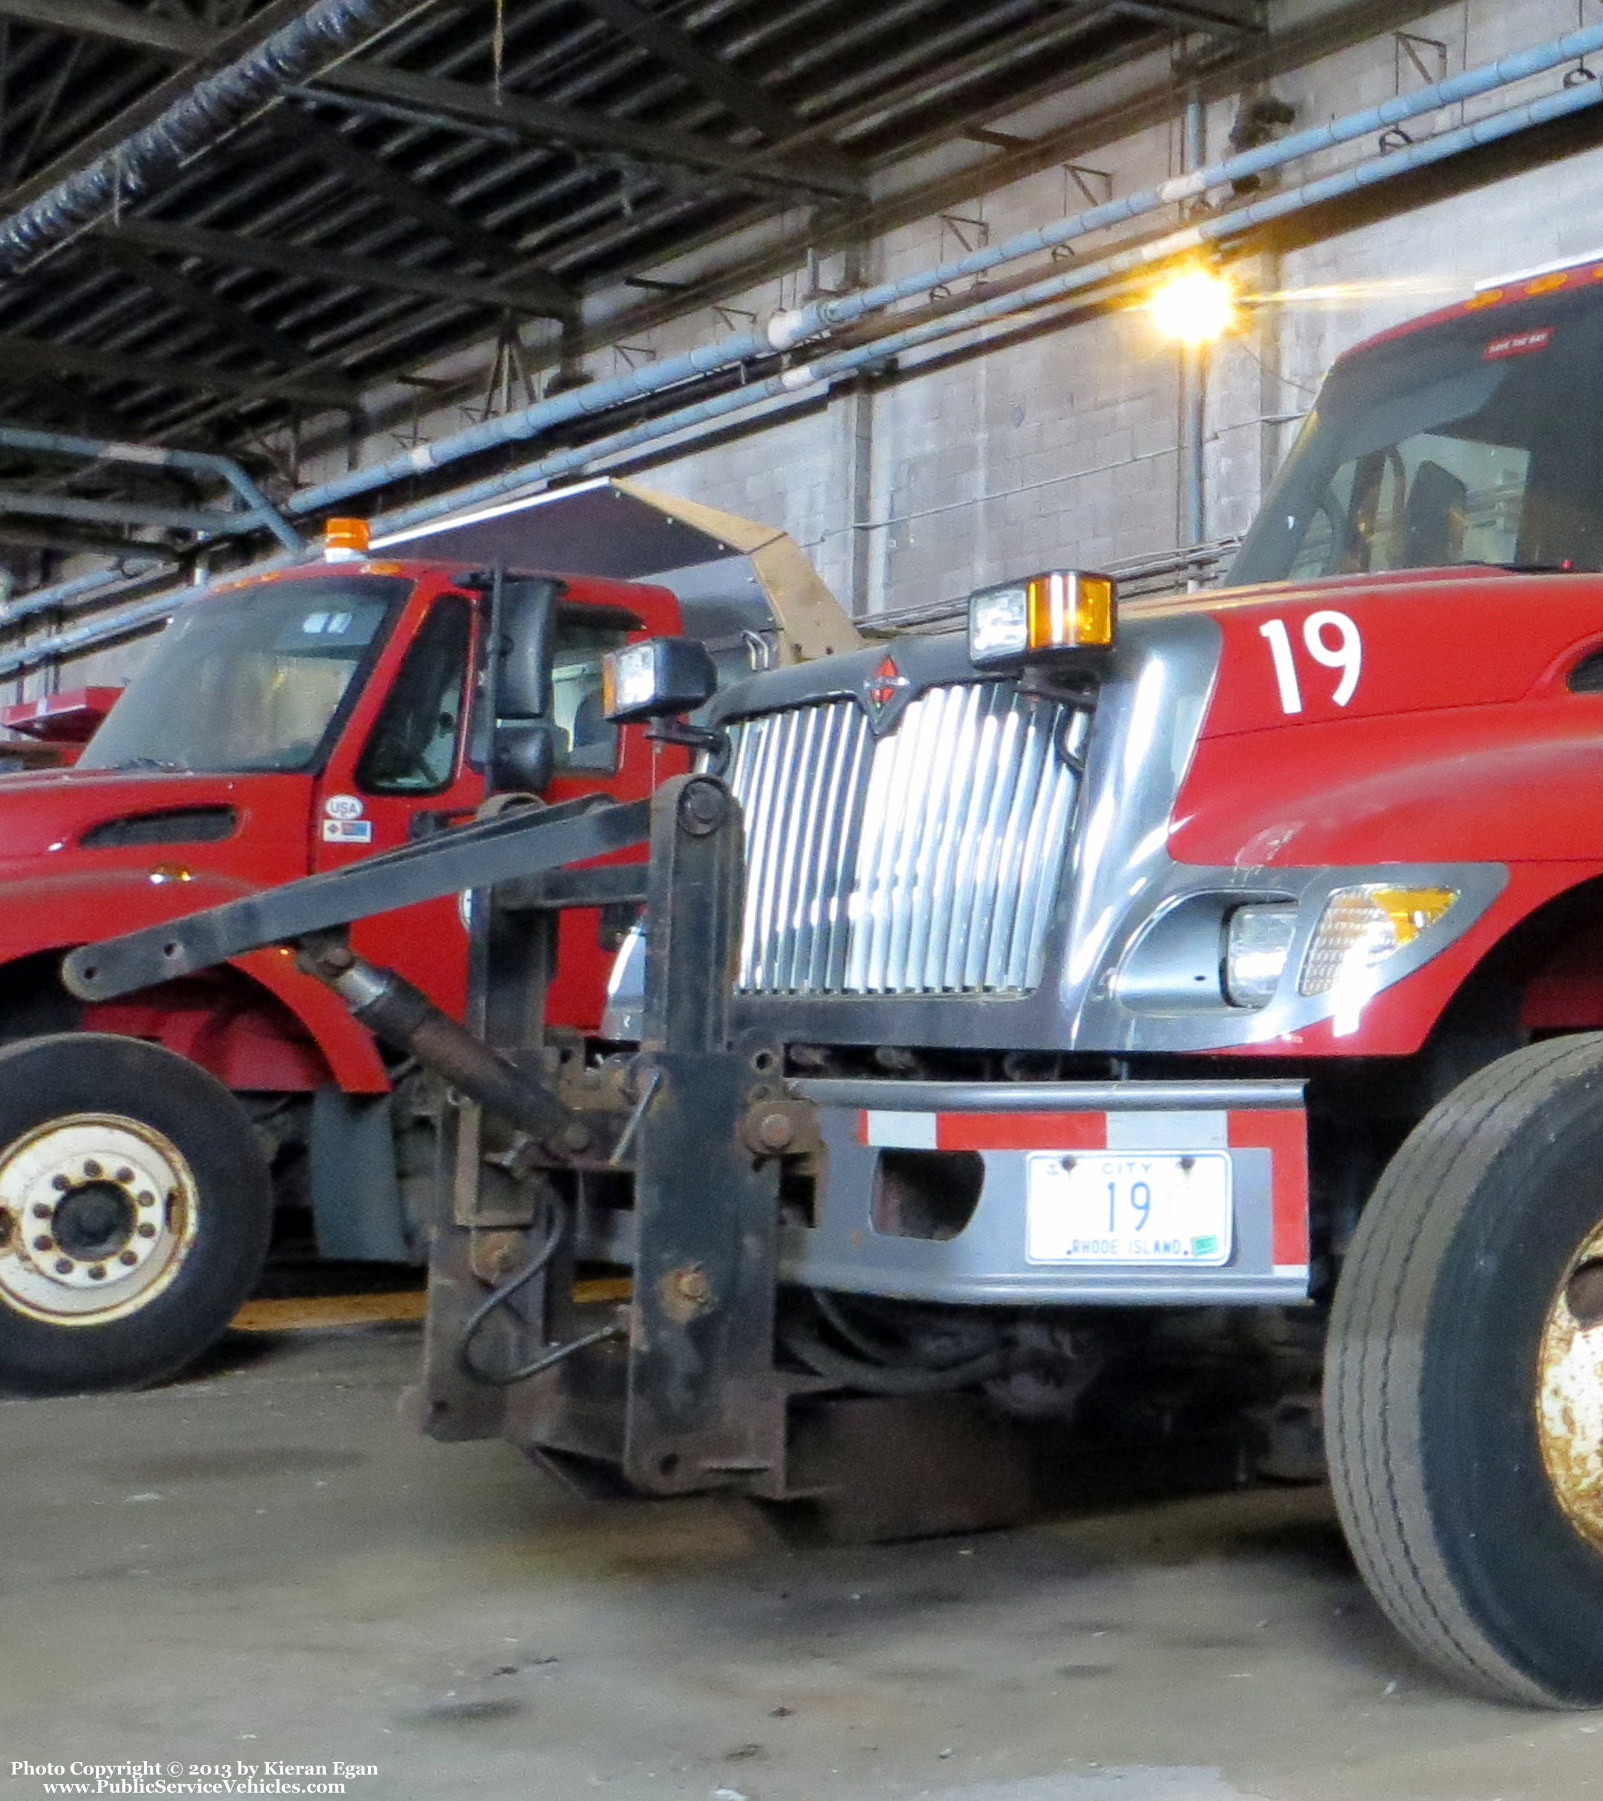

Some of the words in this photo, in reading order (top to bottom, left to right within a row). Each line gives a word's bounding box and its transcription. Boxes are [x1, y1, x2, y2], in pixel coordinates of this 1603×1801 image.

[1259, 609, 1363, 715] 19
[330, 802, 358, 814] USA
[1102, 1162, 1153, 1175] CITY
[1107, 1181, 1152, 1233] 19
[1072, 1239, 1119, 1255] RHODE
[1127, 1239, 1182, 1255] ISLAND
